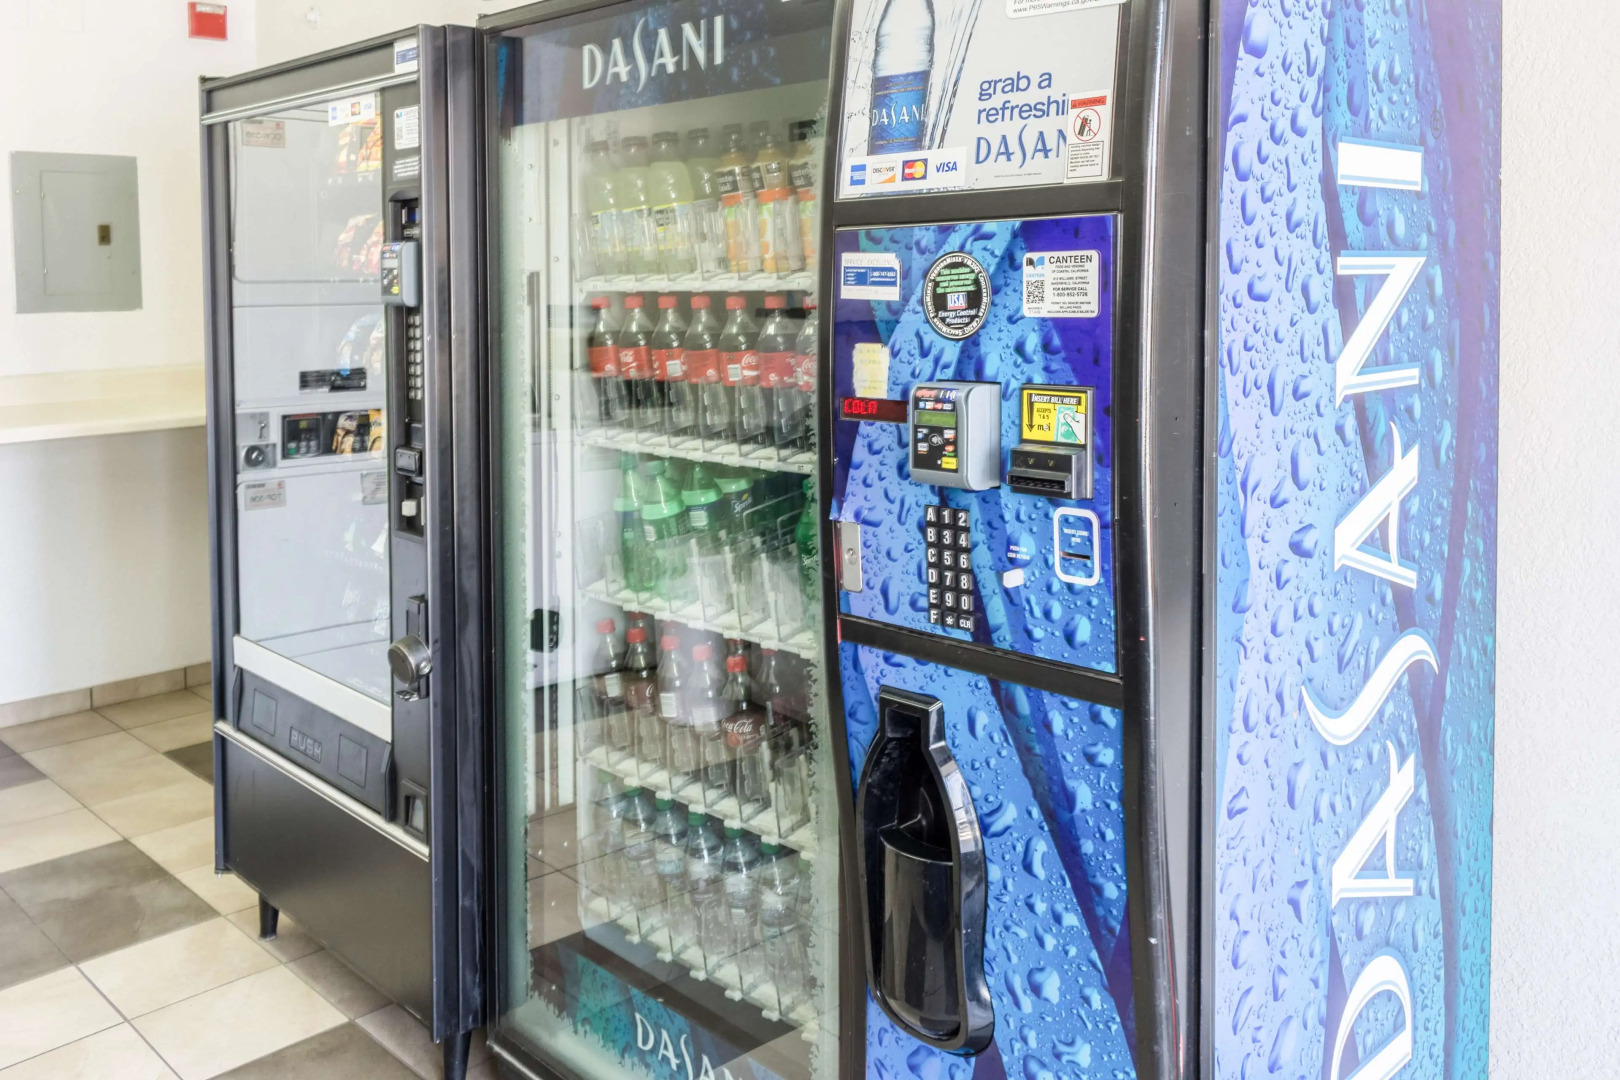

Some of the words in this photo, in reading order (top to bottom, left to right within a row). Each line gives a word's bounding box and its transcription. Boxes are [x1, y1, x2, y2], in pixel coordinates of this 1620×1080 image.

[582, 14, 724, 93] DASANI
[978, 71, 1031, 101] grab
[1038, 72, 1052, 90] a
[872, 101, 925, 129] DASANI
[977, 93, 1069, 124] refreshi
[872, 166, 895, 174] DISCOVER
[936, 161, 958, 173] VISA
[1048, 254, 1093, 264] CANTEEN
[950, 294, 966, 306] USA
[1032, 393, 1050, 402] INSERT
[1038, 422, 1050, 431] mei
[927, 508, 934, 521] A
[943, 510, 949, 524] 1
[959, 513, 966, 526] 2
[928, 529, 935, 542] B
[943, 531, 950, 544] 3
[959, 534, 966, 547] 4
[928, 549, 935, 562] C
[944, 551, 950, 565] 5
[960, 555, 967, 568] 6
[928, 569, 936, 582] D
[944, 572, 951, 585] 7
[961, 576, 967, 589] 8
[930, 590, 936, 603] E
[946, 593, 952, 607] 9
[962, 596, 968, 610] 0
[931, 611, 937, 623] F
[960, 619, 971, 628] CLR
[721, 718, 754, 734] Coca-Cola
[291, 730, 321, 758] PUSH
